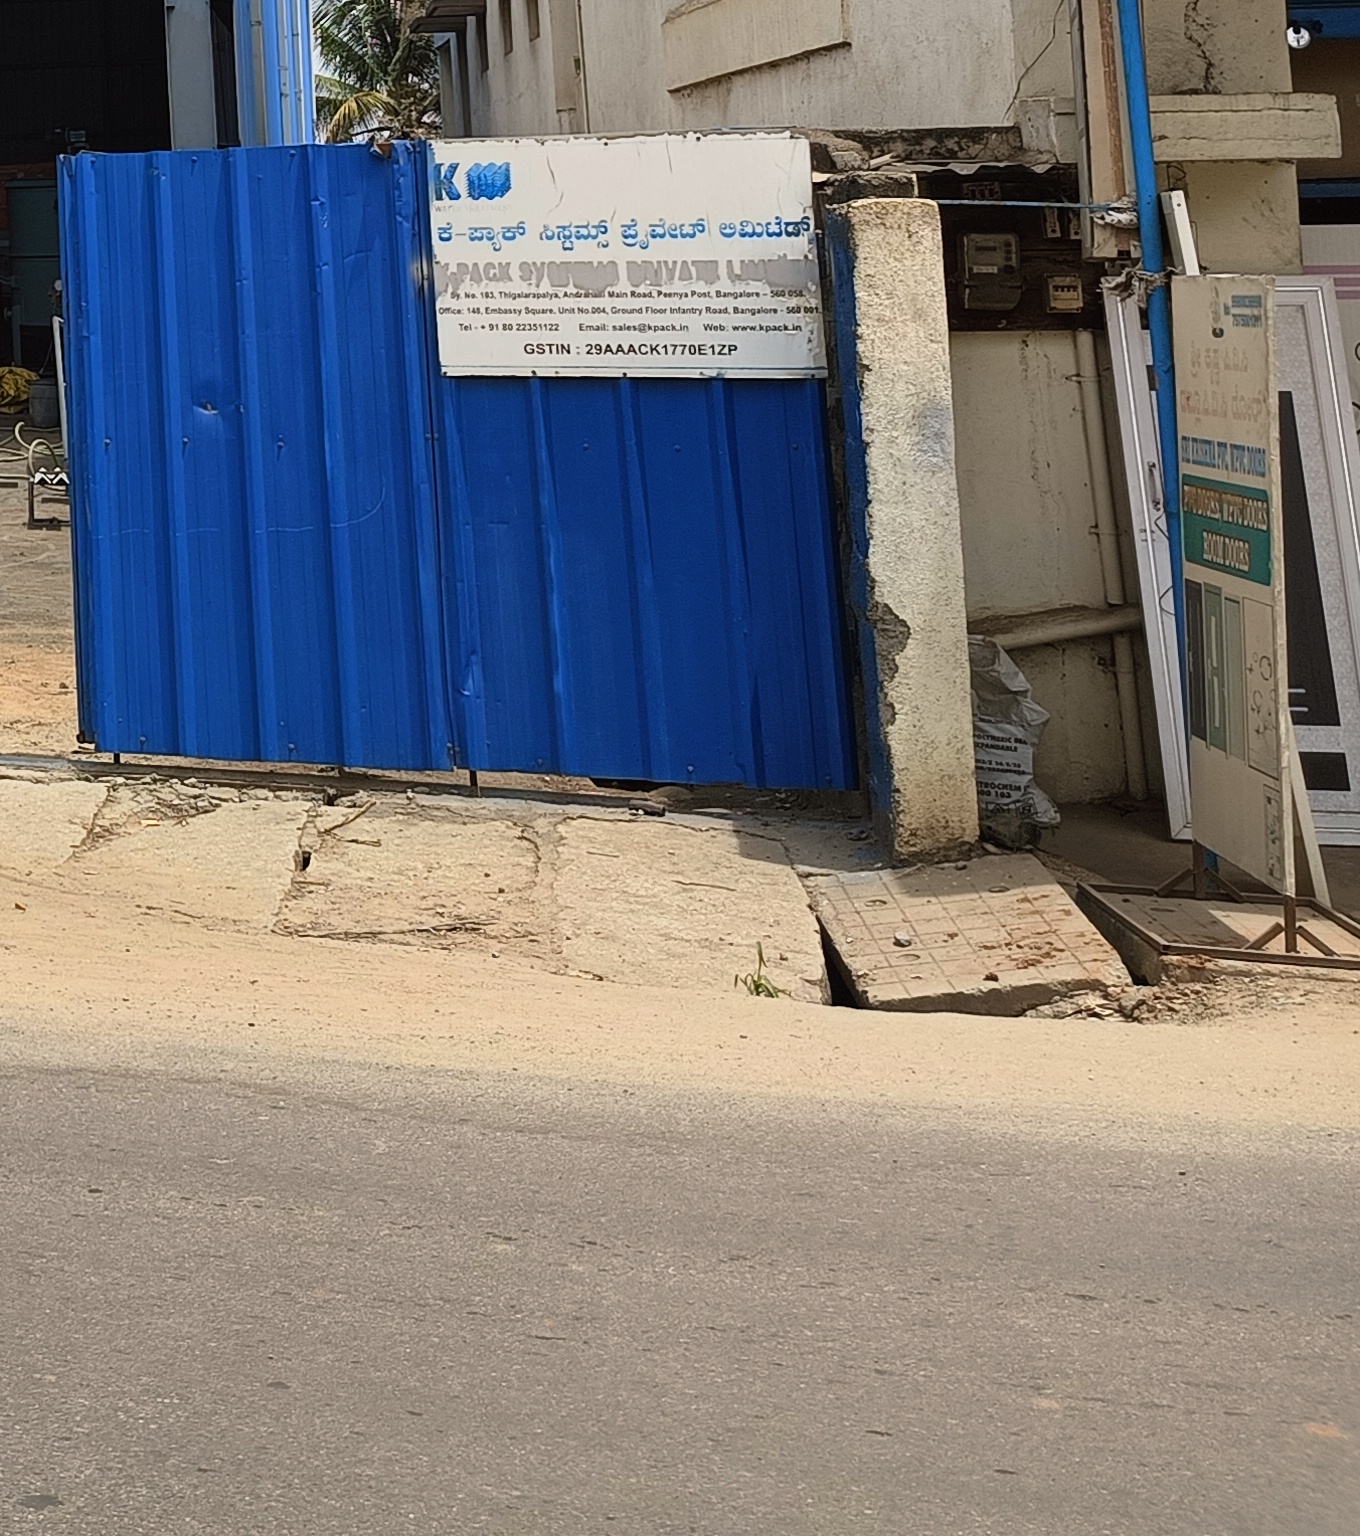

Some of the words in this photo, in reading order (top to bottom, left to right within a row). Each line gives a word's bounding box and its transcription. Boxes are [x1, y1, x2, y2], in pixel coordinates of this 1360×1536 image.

[464, 291, 478, 299] No.
[607, 291, 628, 299] Main
[630, 290, 655, 299] Road,
[657, 290, 688, 300] Peenya
[690, 290, 713, 299] Post,
[715, 290, 760, 300] Bangalore
[438, 307, 464, 315] Office:
[485, 307, 521, 316] Embassy
[611, 307, 643, 315] Ground
[645, 307, 667, 315] Floor
[669, 307, 703, 317] Infantry
[705, 307, 731, 316] Road,
[733, 307, 778, 316] Bangalore
[786, 306, 802, 314] 560
[458, 323, 472, 331] Tel
[488, 323, 499, 331] 91
[502, 323, 513, 331] 80
[515, 323, 560, 331] 22351122
[579, 323, 609, 331] Email:
[612, 323, 689, 333] sales@kpack.in
[703, 323, 728, 332] Web:
[731, 323, 802, 333] www.kpack.in
[523, 343, 571, 355] GSTIN
[585, 343, 738, 356] 29AAACK1770E1ZP
[1243, 496, 1268, 531] DOORS
[1224, 536, 1250, 573] DOORS
